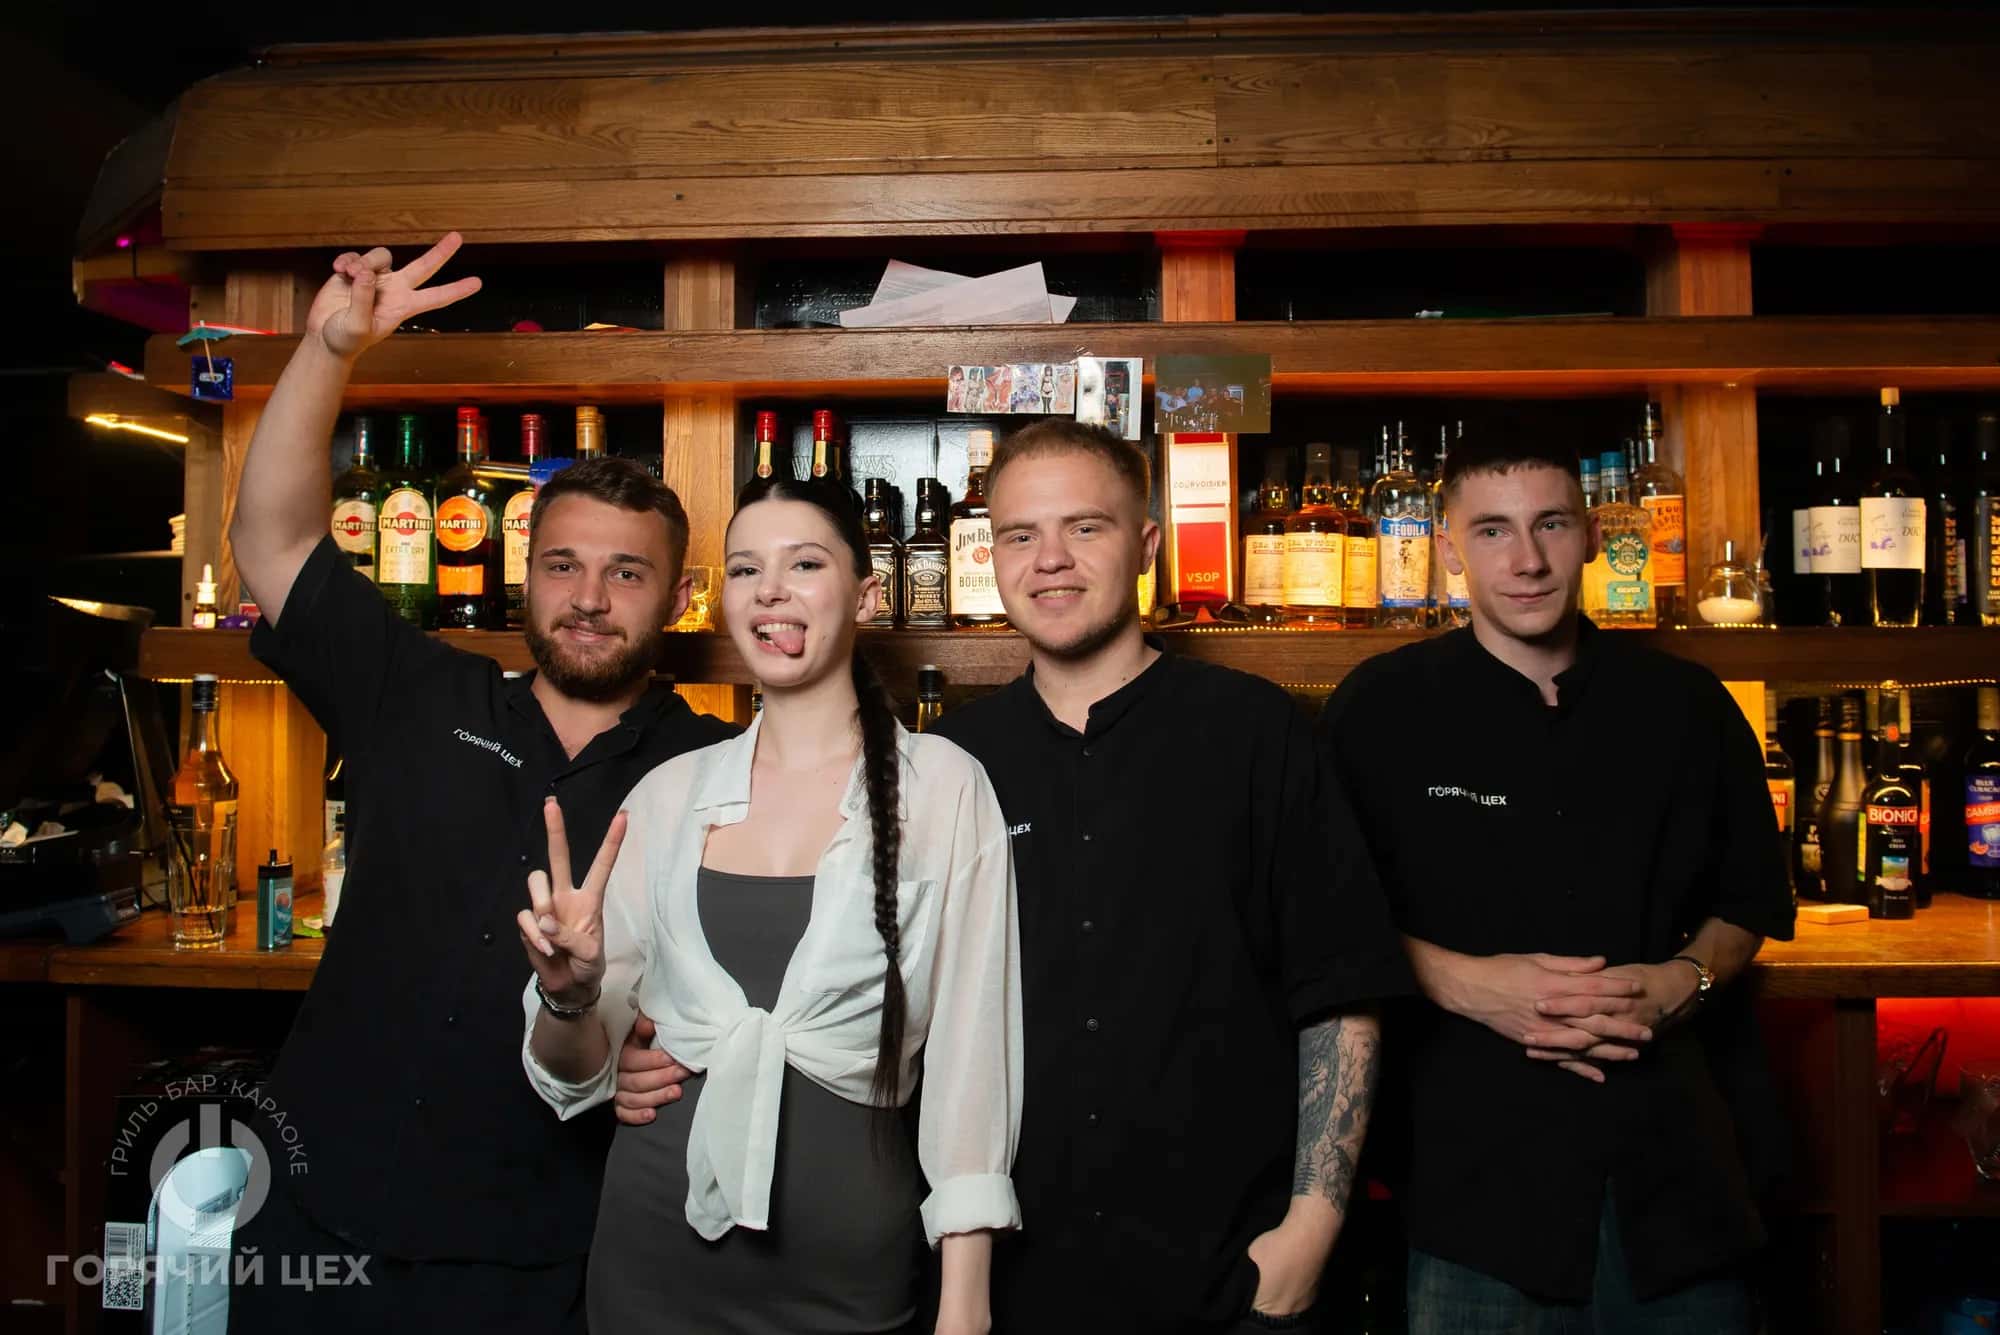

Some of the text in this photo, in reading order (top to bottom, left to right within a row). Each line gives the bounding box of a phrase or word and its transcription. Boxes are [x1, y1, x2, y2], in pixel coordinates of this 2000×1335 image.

[1173, 480, 1228, 489] COURVOISIER
[334, 521, 376, 532] MARTINI
[381, 517, 432, 531] MARTINI
[439, 519, 481, 529] MARTINI
[1389, 523, 1425, 537] TEQUILA
[955, 528, 993, 552] JIM BE
[959, 575, 997, 588] BOURBO
[1186, 572, 1221, 583] VSOP
[453, 728, 523, 768] ГОРЯЧИЙ ЦЕХ
[1428, 785, 1507, 806] ГОРЯЧЙ ЦЕХ
[1008, 823, 1032, 837] ЦЕХ
